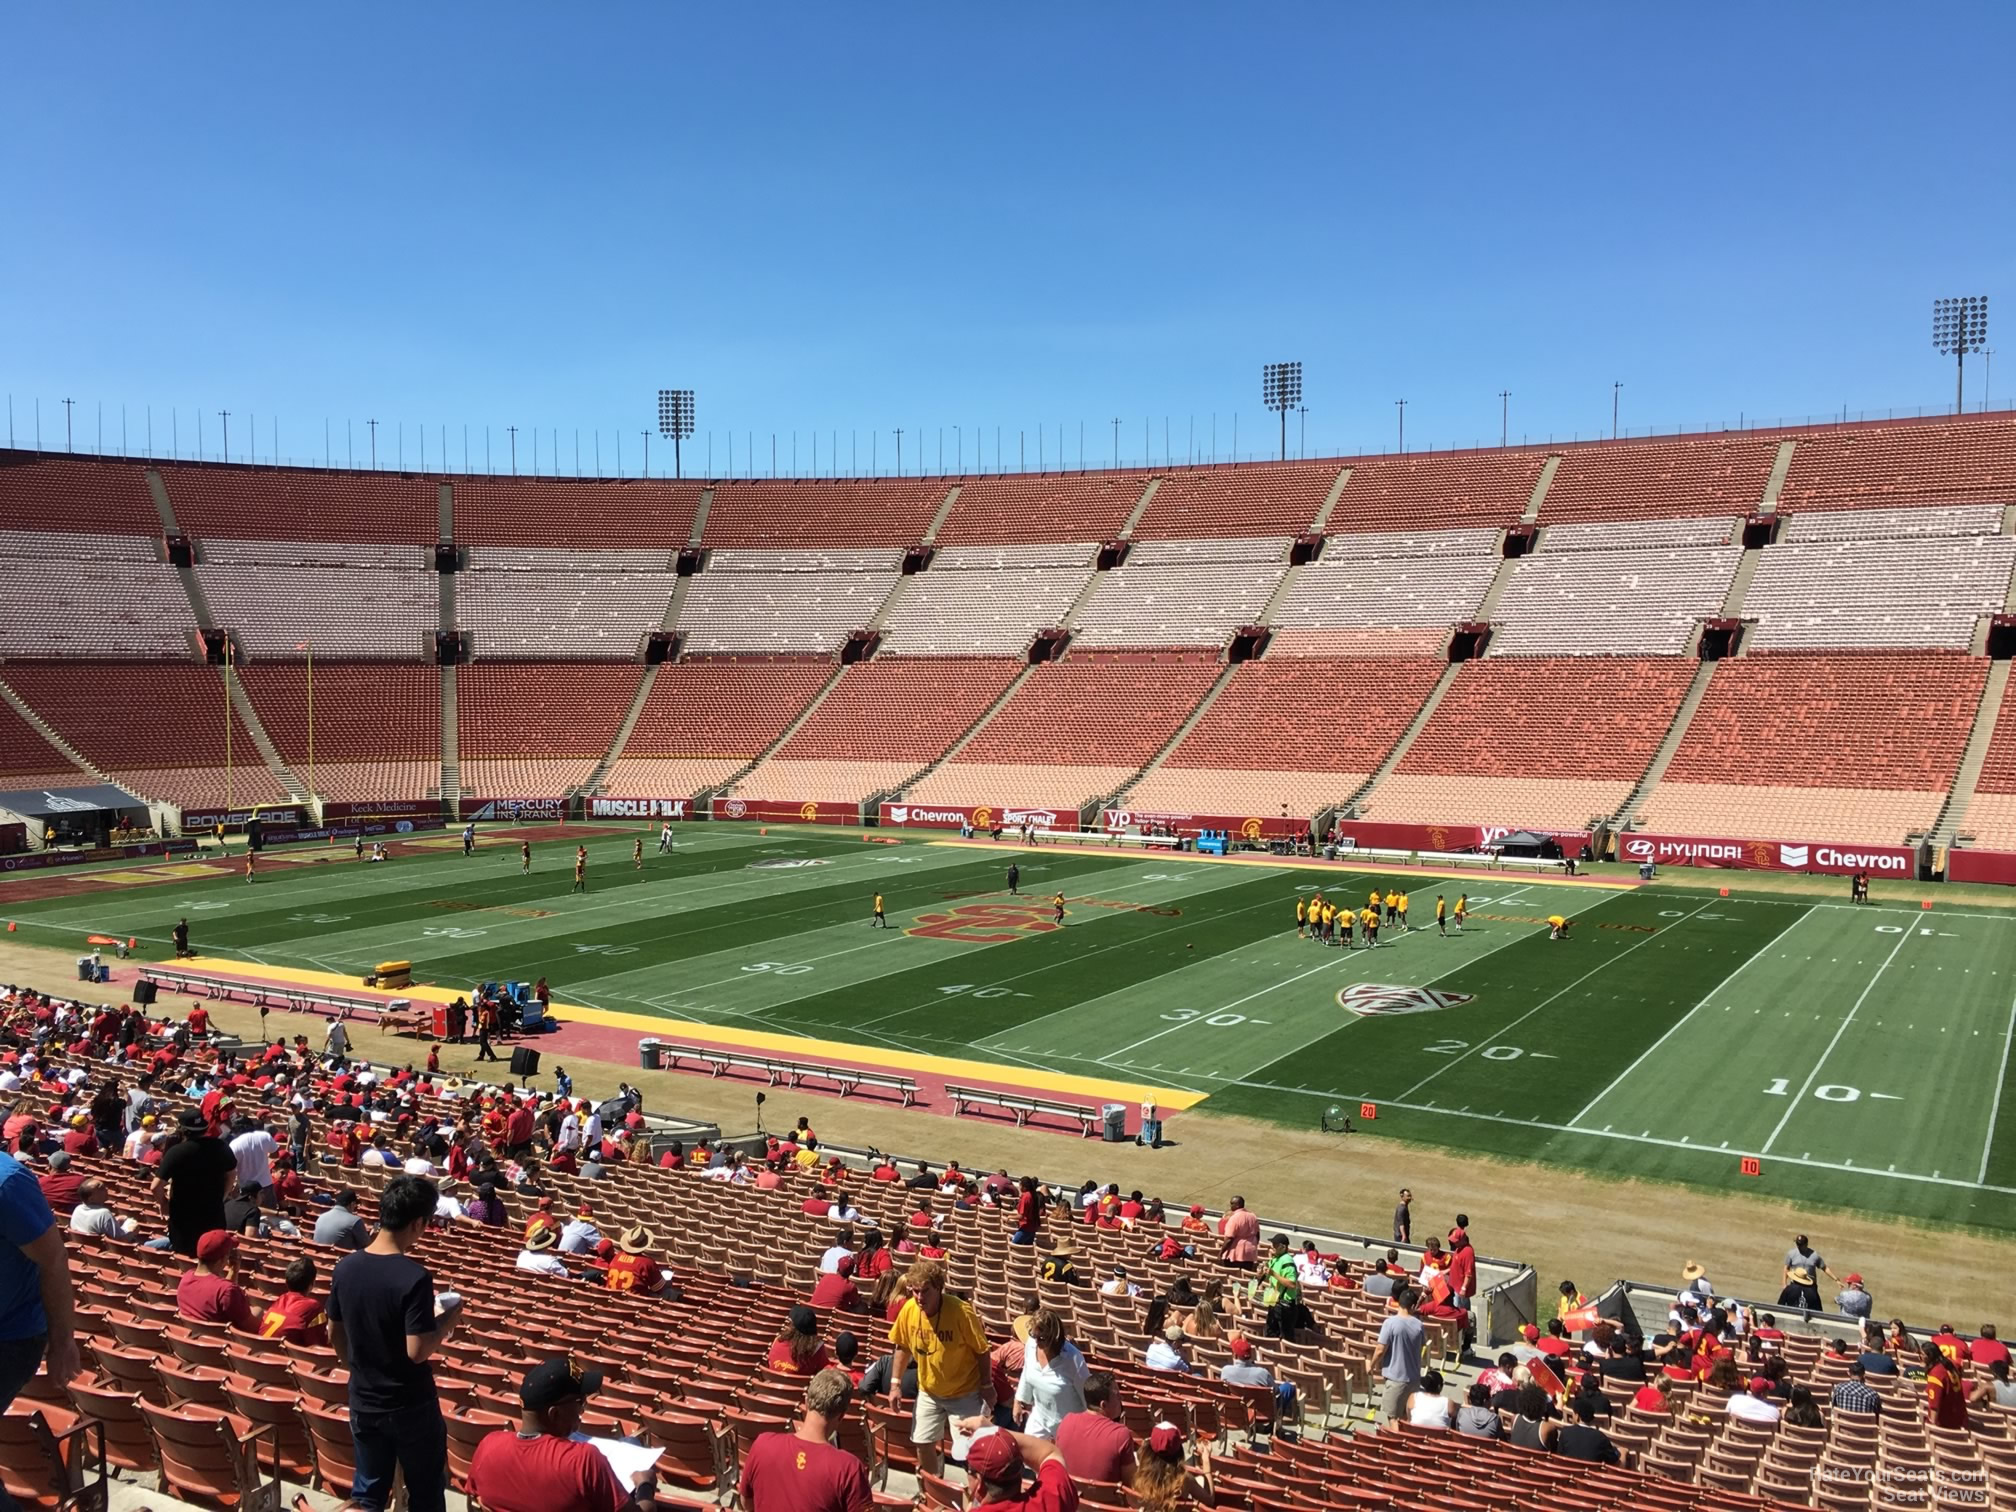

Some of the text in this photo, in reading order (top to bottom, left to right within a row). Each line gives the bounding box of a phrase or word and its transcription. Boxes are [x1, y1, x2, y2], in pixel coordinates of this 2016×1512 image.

[351, 802, 417, 813] Keck Medicine
[497, 799, 563, 811] MERCURY
[592, 800, 648, 817] MUSCLE
[911, 808, 964, 822] Chevron
[1003, 813, 1056, 826] SPORT CHALET
[1108, 812, 1131, 828] yp
[1660, 842, 1741, 859] HYUNDAI
[1815, 848, 1905, 869] Chevron
[741, 962, 814, 975] 50
[936, 984, 1013, 998] 40
[1159, 1008, 1247, 1026] 30
[1422, 1039, 1524, 1061] 20
[1763, 1078, 1861, 1102] 10
[1362, 1106, 1374, 1117] 20
[1743, 1159, 1757, 1174] 10
[1044, 1261, 1056, 1281] 2
[263, 1312, 286, 1338] 7
